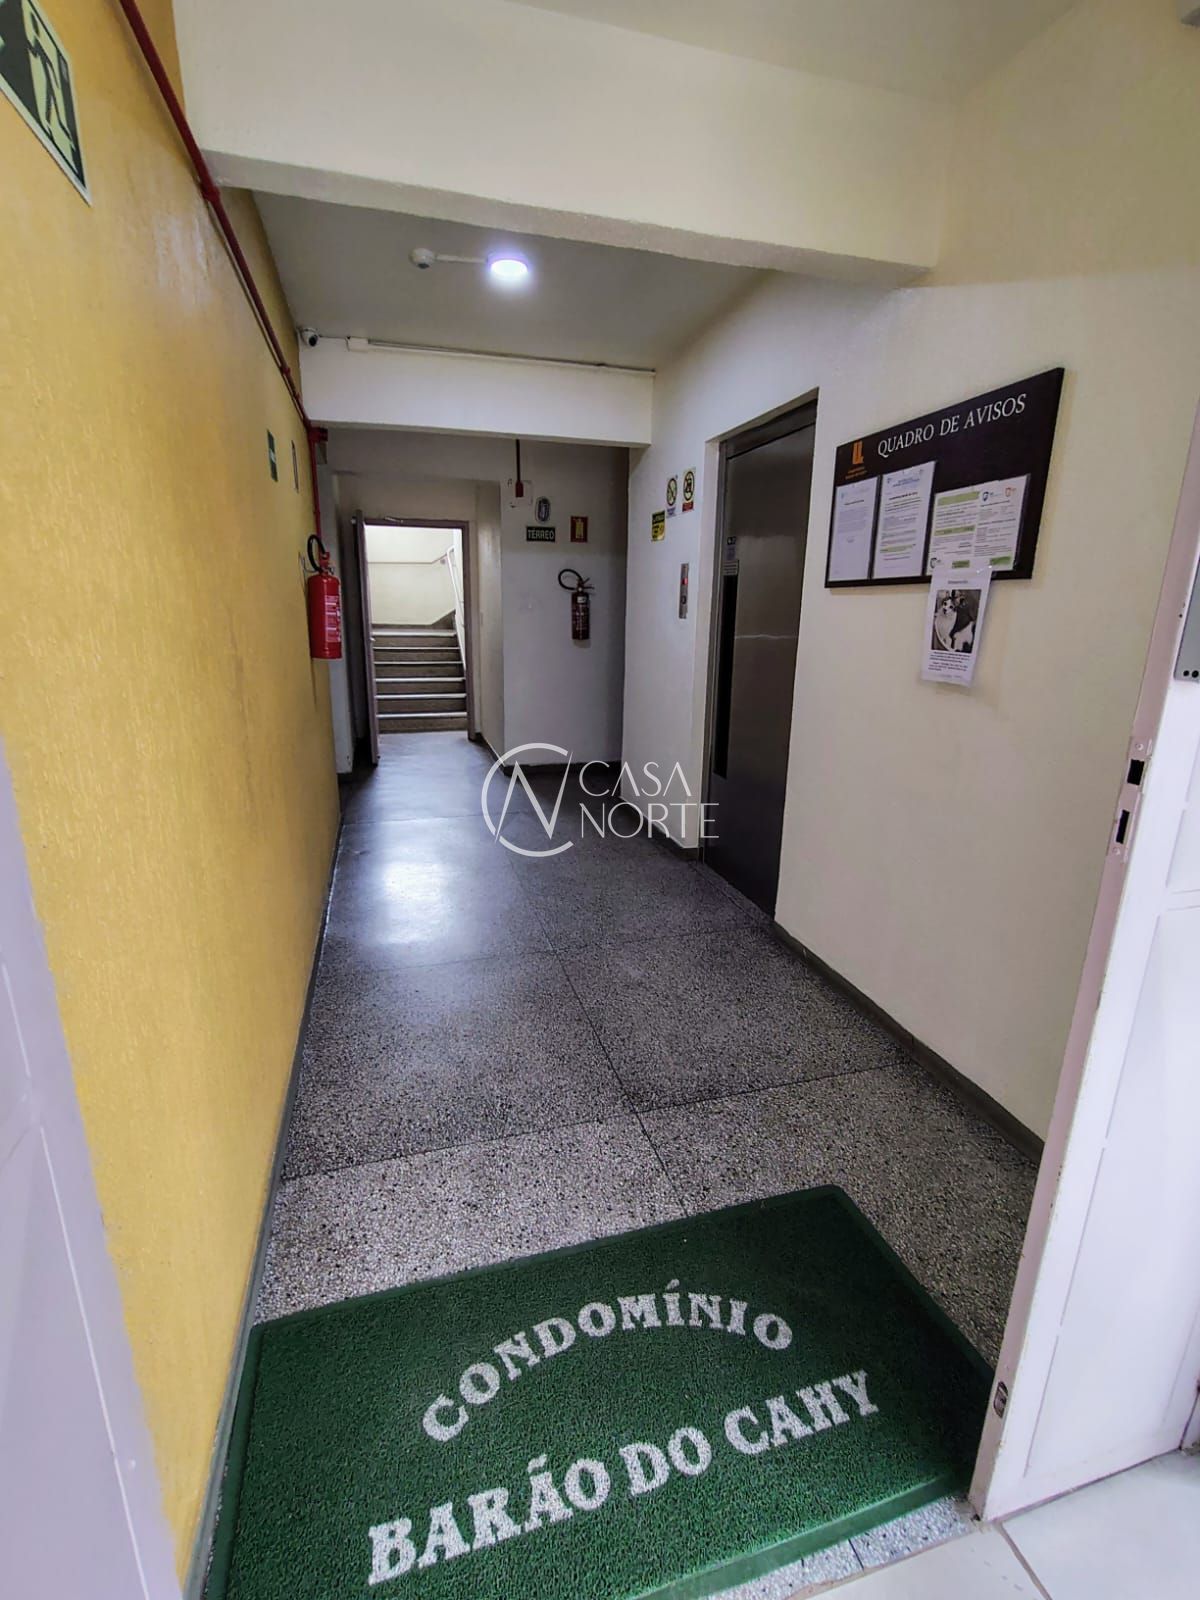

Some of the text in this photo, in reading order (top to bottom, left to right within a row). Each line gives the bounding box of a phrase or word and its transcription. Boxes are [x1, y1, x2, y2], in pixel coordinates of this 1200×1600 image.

[878, 393, 1027, 458] QUADRO DE AVISOS
[422, 1279, 793, 1442] CONDOMÍNIO
[367, 1369, 879, 1586] BARÃO DO CAHY
